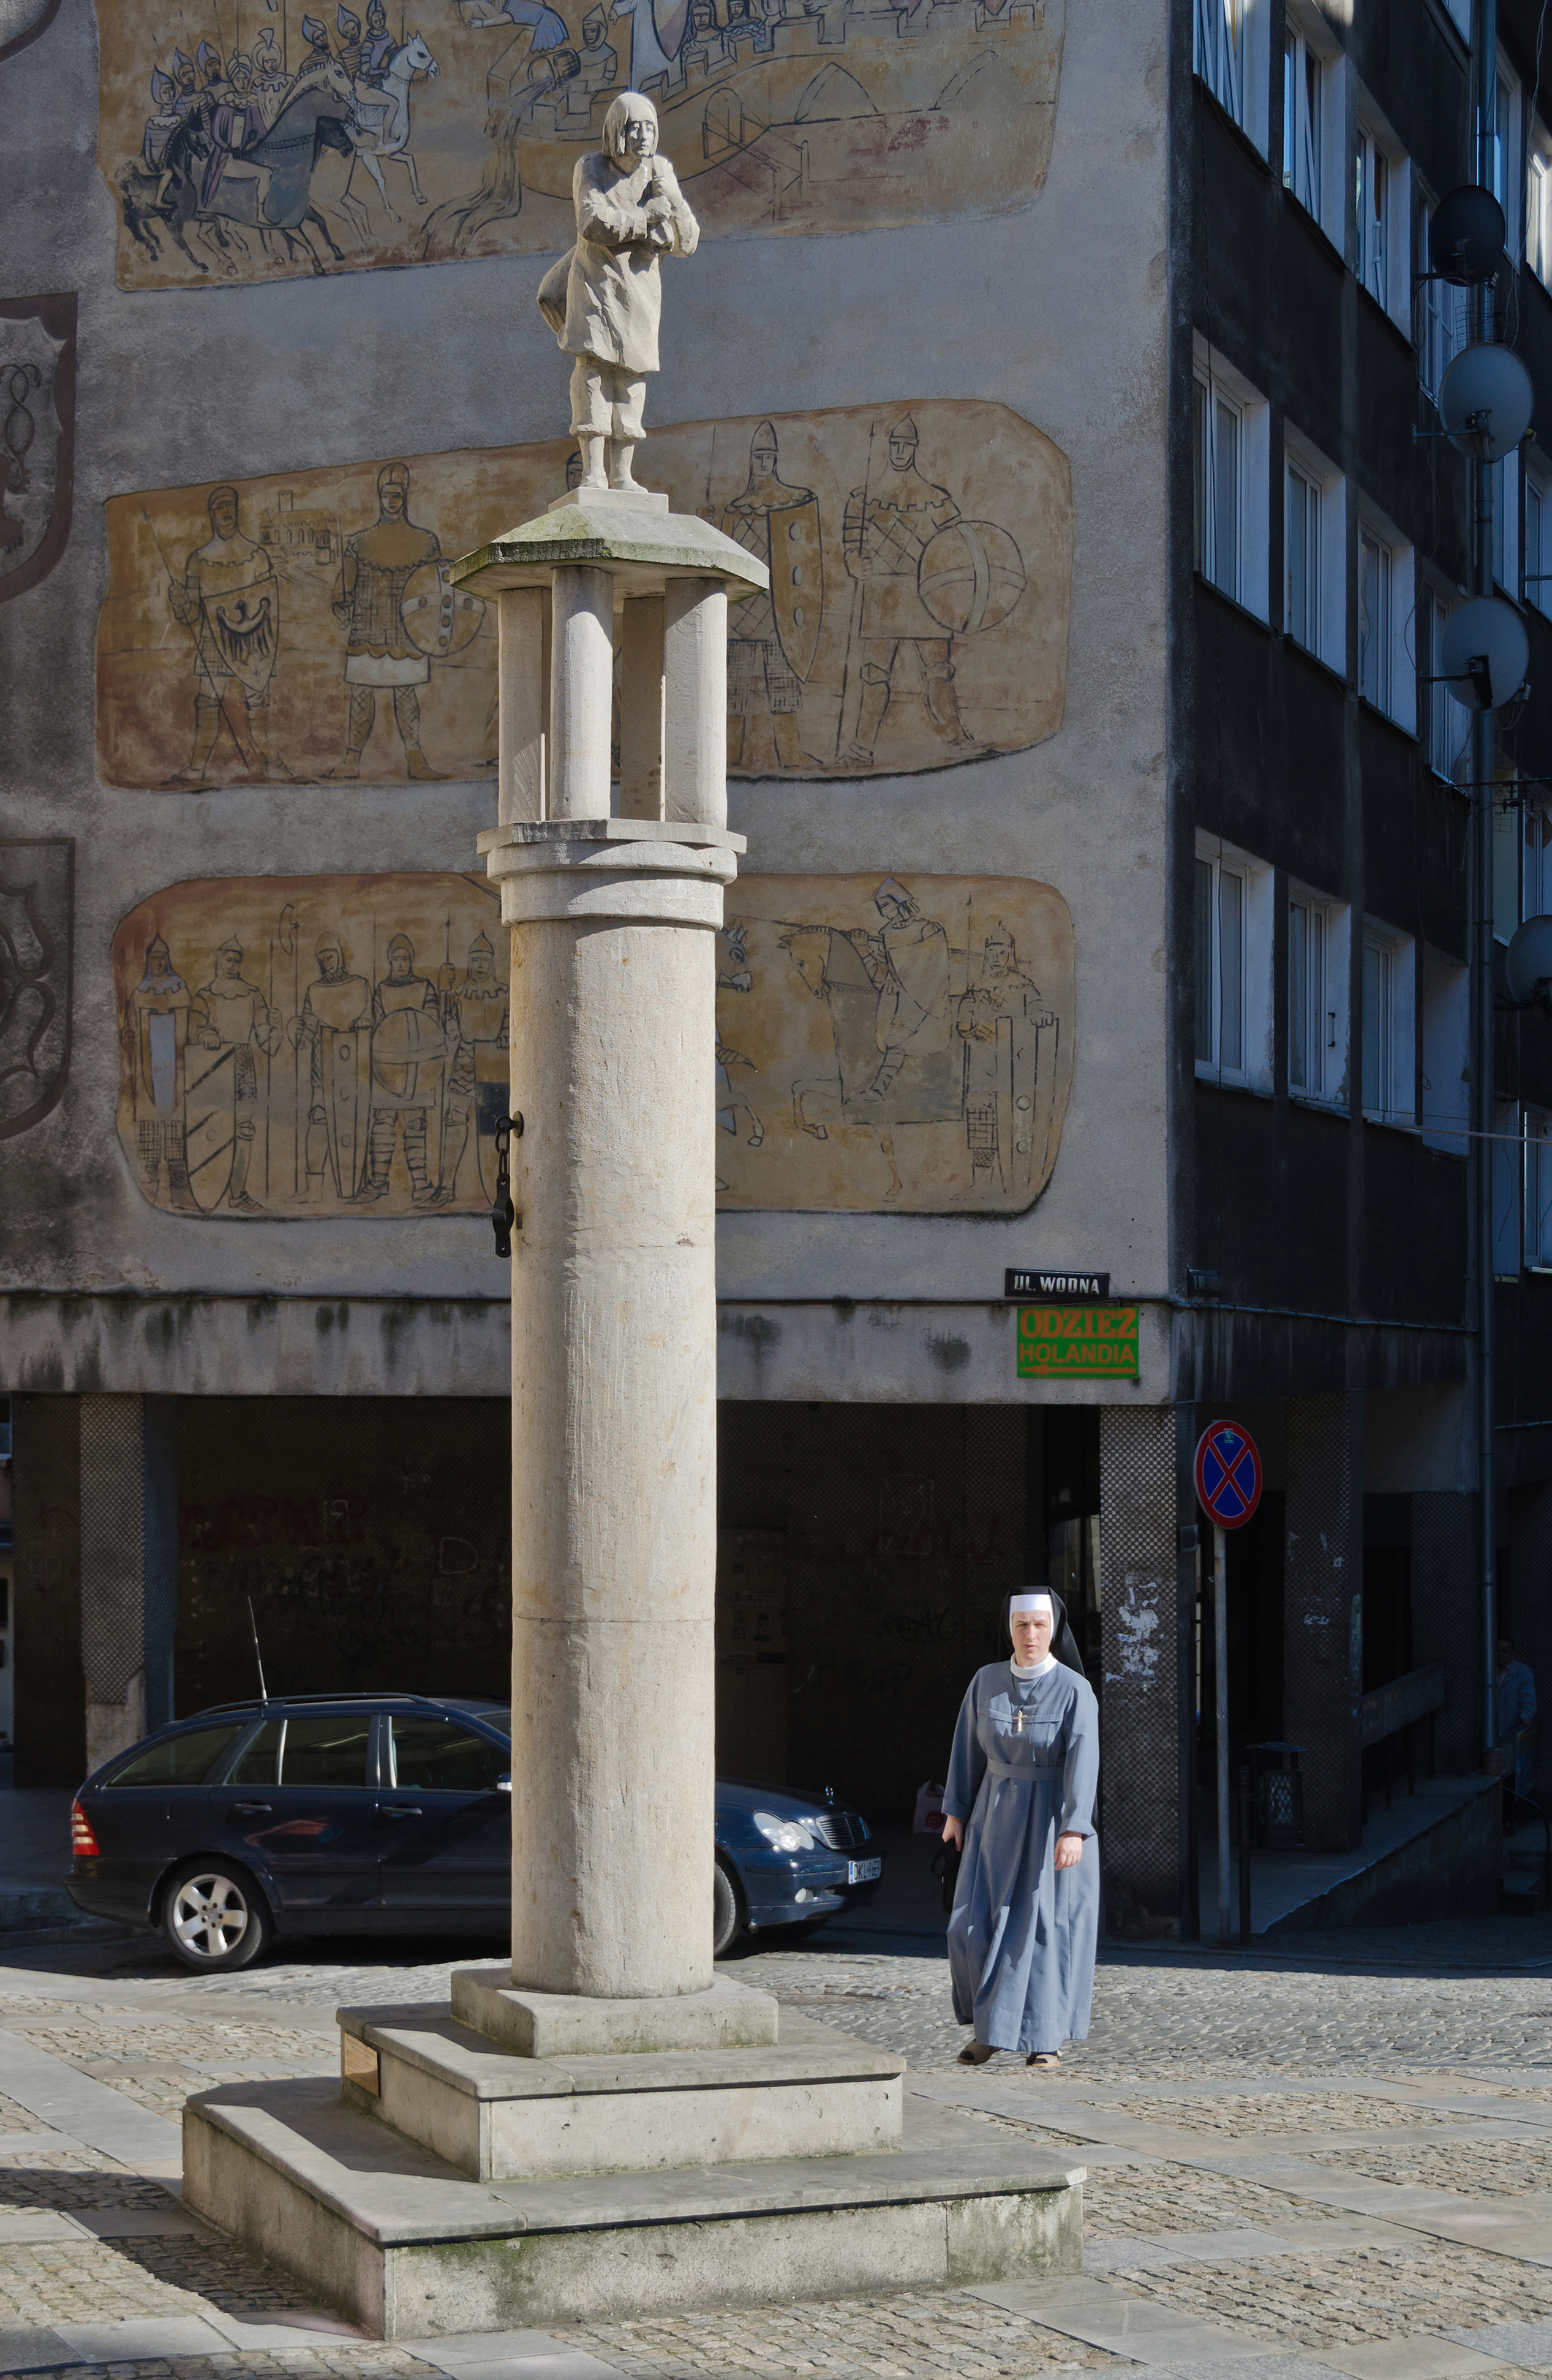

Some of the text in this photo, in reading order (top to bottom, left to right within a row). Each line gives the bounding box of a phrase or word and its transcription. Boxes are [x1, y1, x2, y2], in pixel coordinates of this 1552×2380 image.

[1014, 1275, 1100, 1294] UL. WODNA
[1019, 1343, 1136, 1363] HOLANDIA
